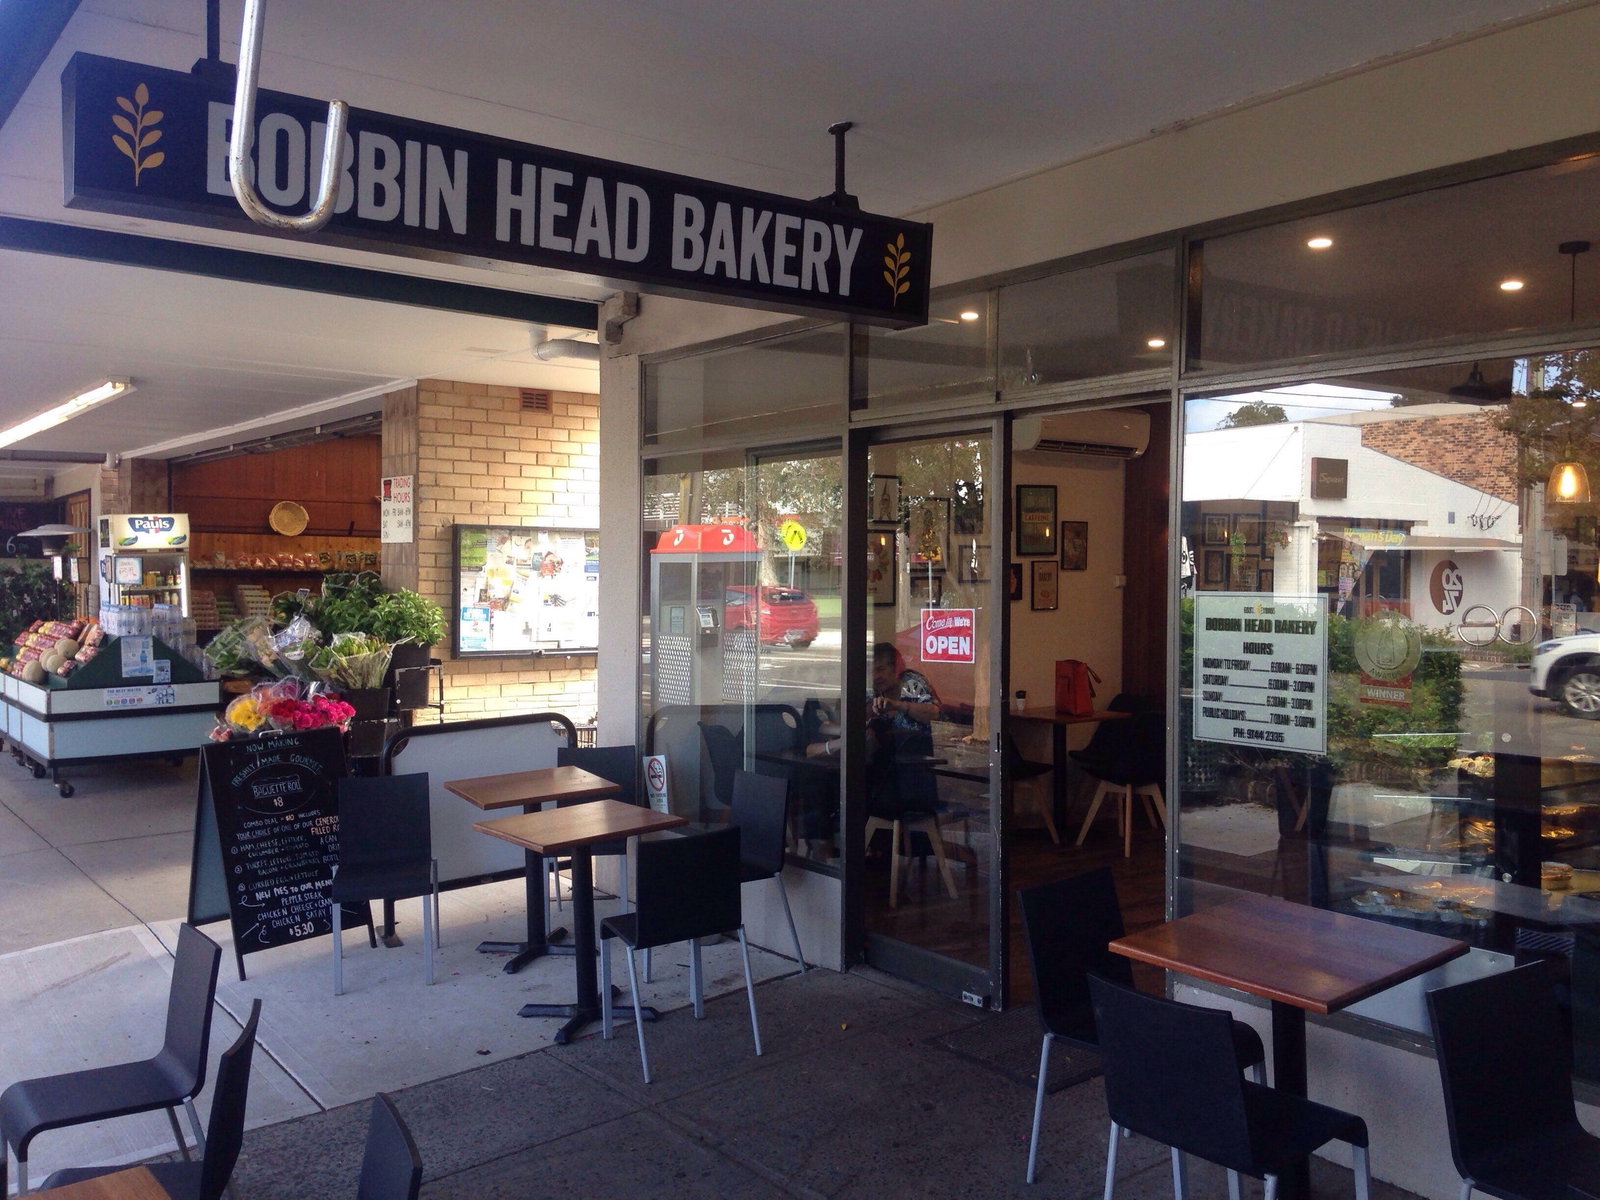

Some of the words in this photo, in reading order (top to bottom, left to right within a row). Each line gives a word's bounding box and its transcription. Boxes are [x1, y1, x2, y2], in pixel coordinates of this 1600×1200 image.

[206, 100, 468, 235] BOBBIN
[495, 158, 651, 263] HEAD
[671, 192, 864, 297] BAKERY
[134, 519, 170, 529] Pauls
[1206, 617, 1242, 632] BOBBIN
[1244, 618, 1273, 633] HEAD
[1274, 619, 1318, 635] BAKERY
[926, 635, 970, 655] OPEN
[1243, 642, 1274, 655] HOURS
[1366, 687, 1405, 700] WINNER
[246, 743, 264, 752] NOW
[267, 737, 300, 749] MAKING
[261, 754, 281, 765] MADE
[253, 781, 287, 797] BAGUETTE
[273, 796, 284, 807] $8
[243, 819, 263, 829] COMBO
[302, 820, 313, 828] OUR
[310, 826, 330, 836] FILLED
[255, 890, 271, 901] NEW
[273, 886, 289, 896] PIES
[300, 882, 314, 891] OUR
[281, 894, 302, 906] PEPPER
[303, 891, 325, 901] STEAK
[257, 907, 288, 921] CHICKEN
[290, 903, 315, 915] CHEESE
[271, 915, 301, 928] CHICKEN
[306, 909, 326, 920] SATAY
[289, 921, 315, 937] $5.30
